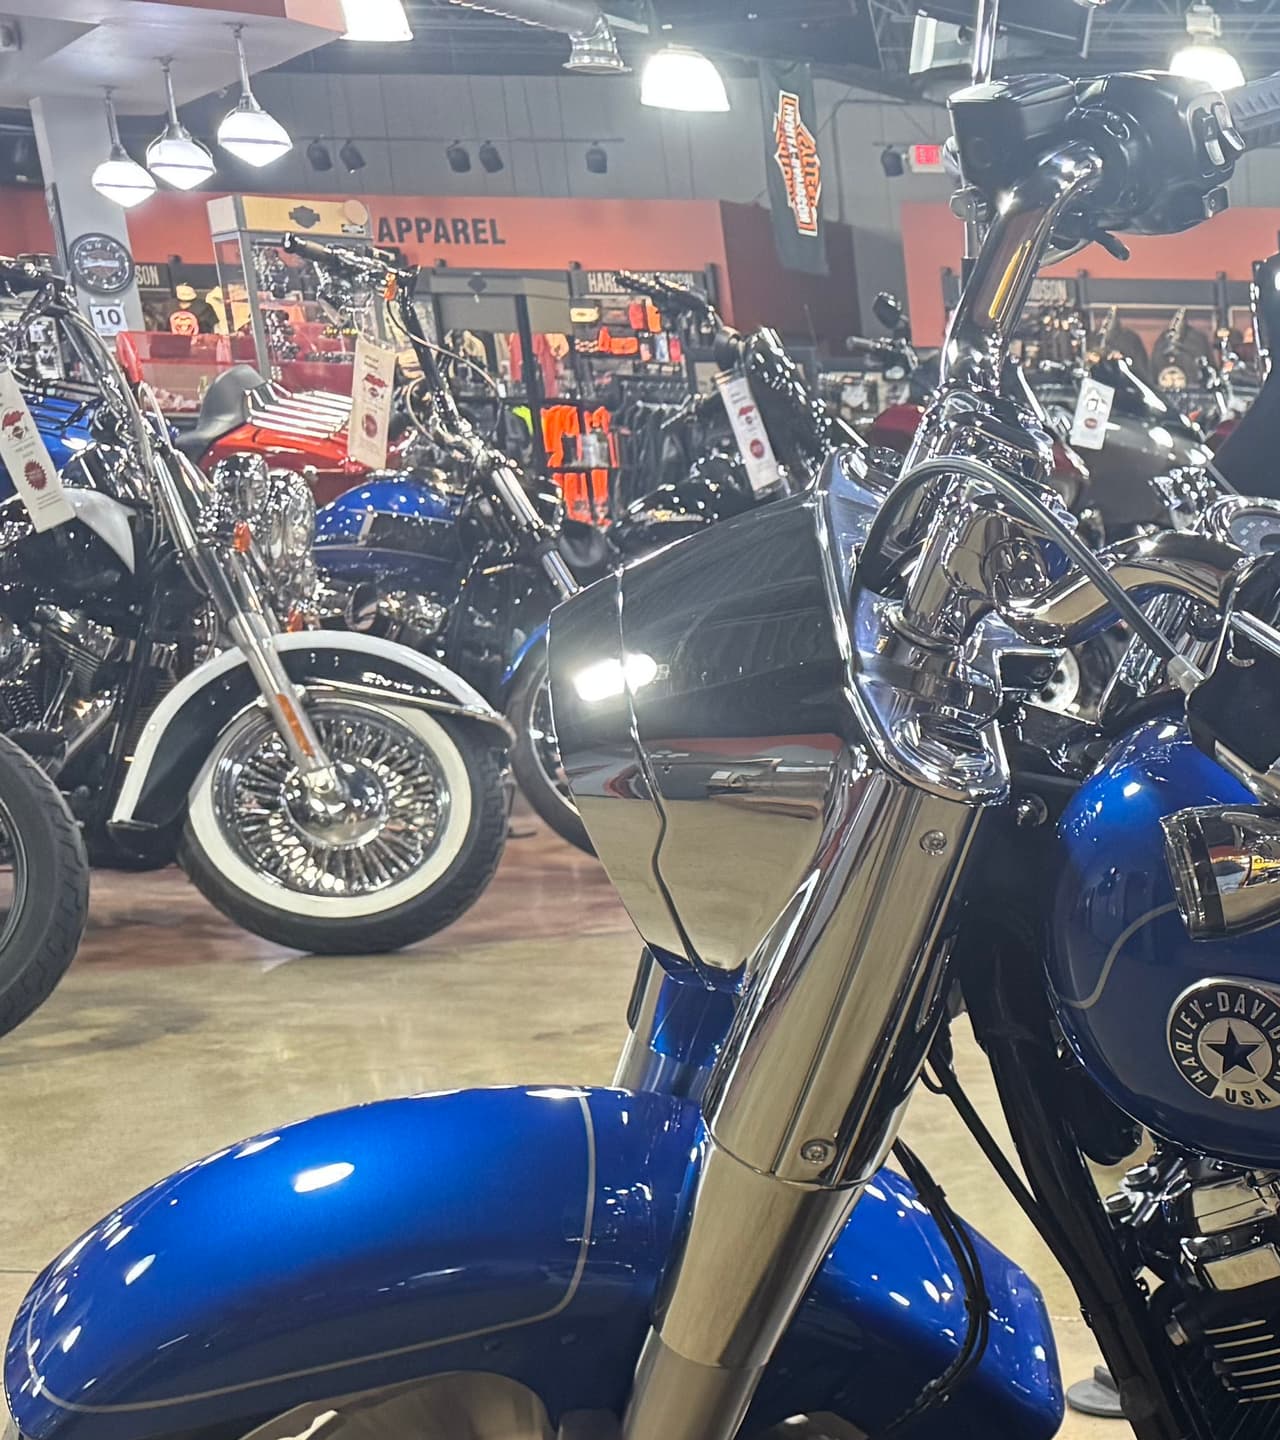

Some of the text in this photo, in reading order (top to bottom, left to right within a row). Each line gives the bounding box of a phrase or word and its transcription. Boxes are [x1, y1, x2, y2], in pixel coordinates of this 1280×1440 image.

[378, 217, 506, 245] APPAREL
[95, 309, 121, 326] 10
[1225, 1087, 1271, 1106] USA
